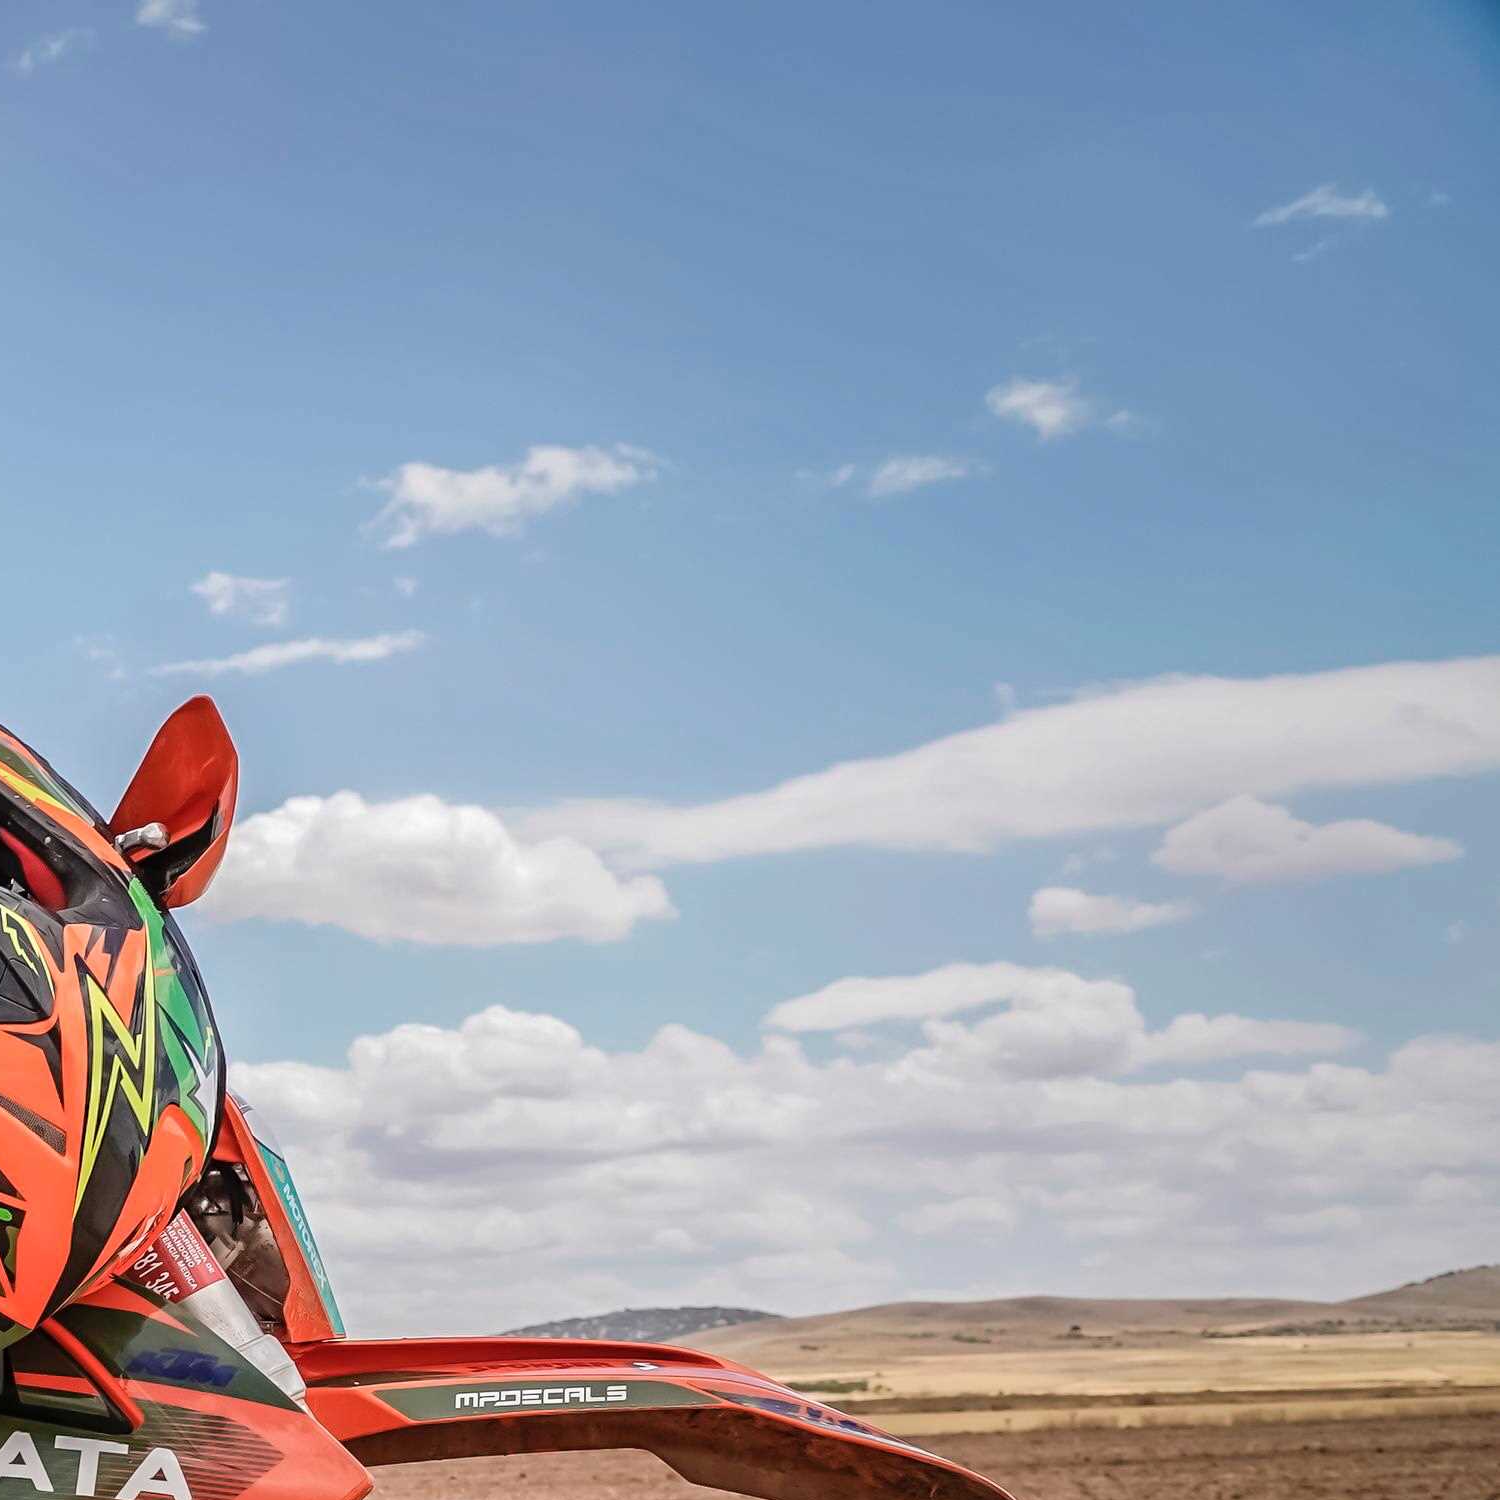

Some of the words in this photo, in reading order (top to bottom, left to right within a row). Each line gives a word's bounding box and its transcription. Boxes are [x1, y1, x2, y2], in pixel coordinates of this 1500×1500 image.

[160, 1230, 181, 1261] TENCIA
[282, 1184, 328, 1289] MOTOREX
[134, 1246, 164, 1279] 81
[124, 1347, 239, 1388] KTM
